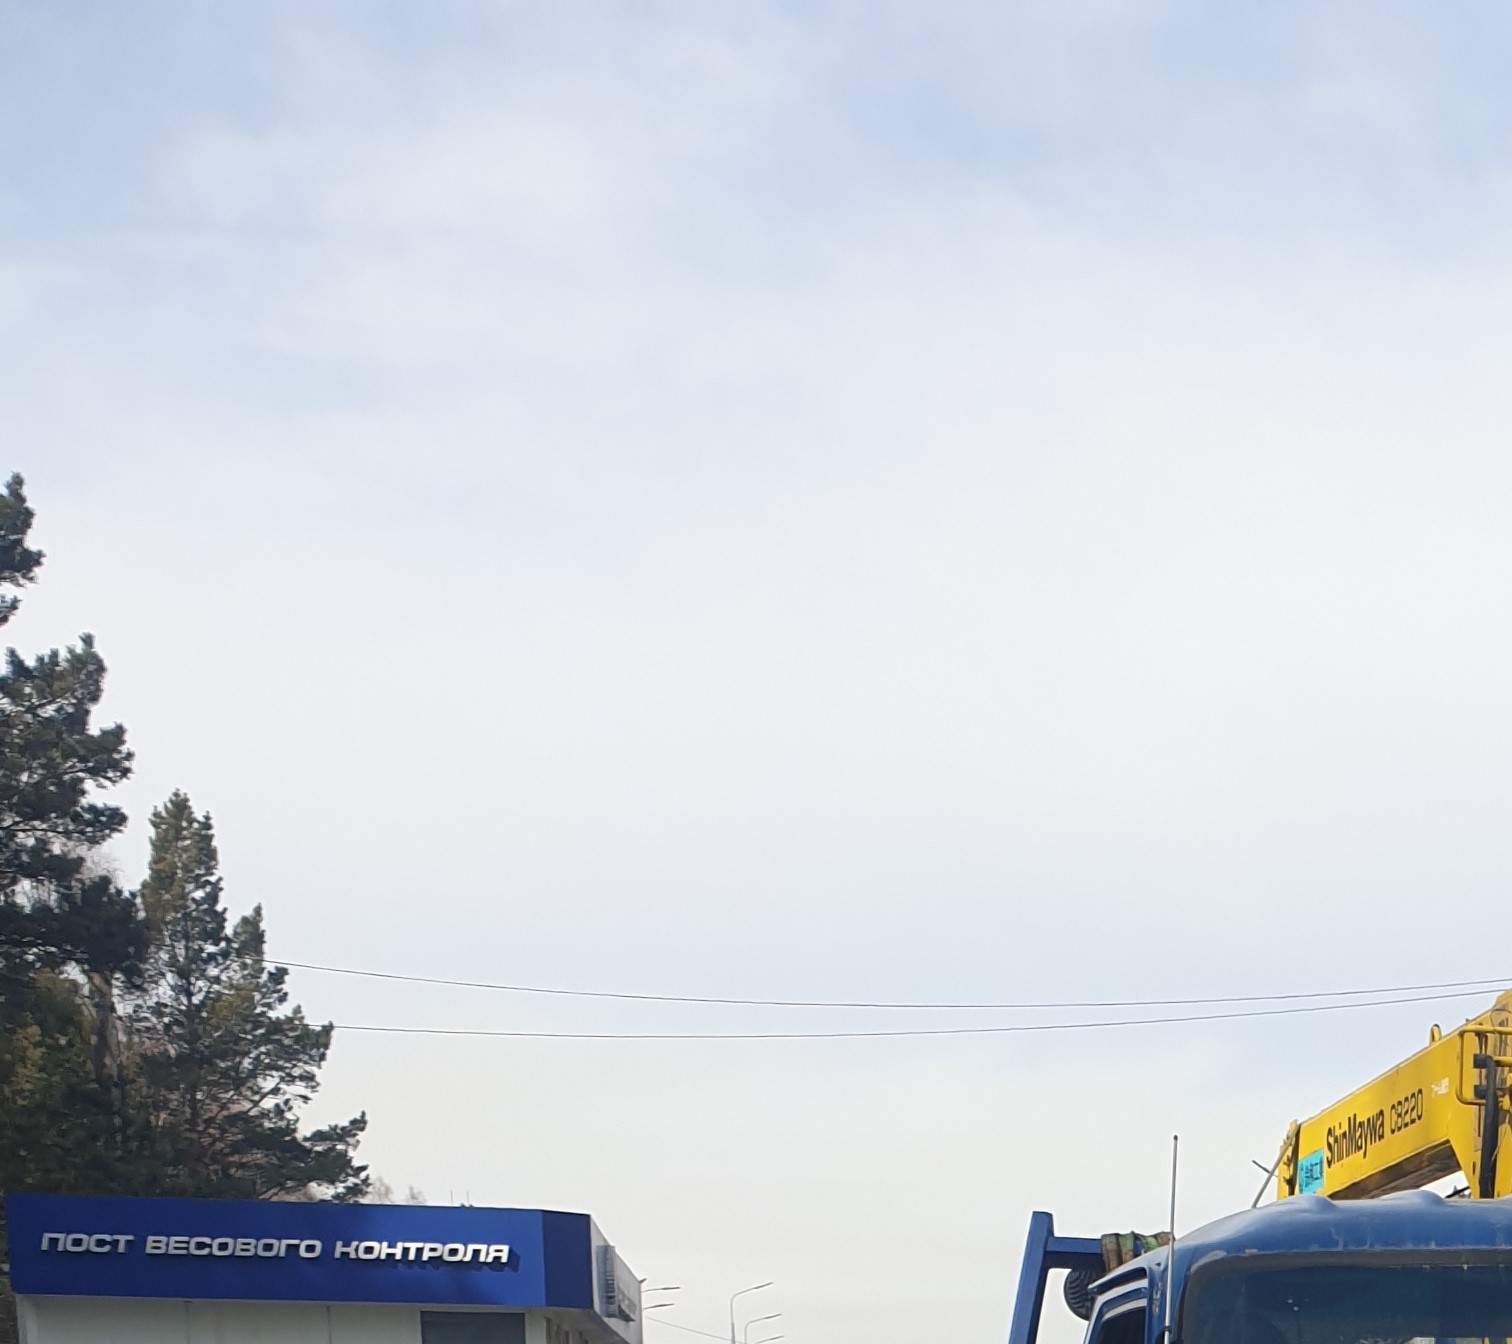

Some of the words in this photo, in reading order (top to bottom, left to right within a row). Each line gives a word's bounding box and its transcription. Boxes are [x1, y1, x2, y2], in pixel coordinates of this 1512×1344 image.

[1326, 1109, 1384, 1168] ShinMaywa
[40, 1232, 135, 1253] ПОСТ
[145, 1235, 323, 1258] ВЕСОВОГО
[334, 1240, 510, 1263] КОНТРОЛЯ
